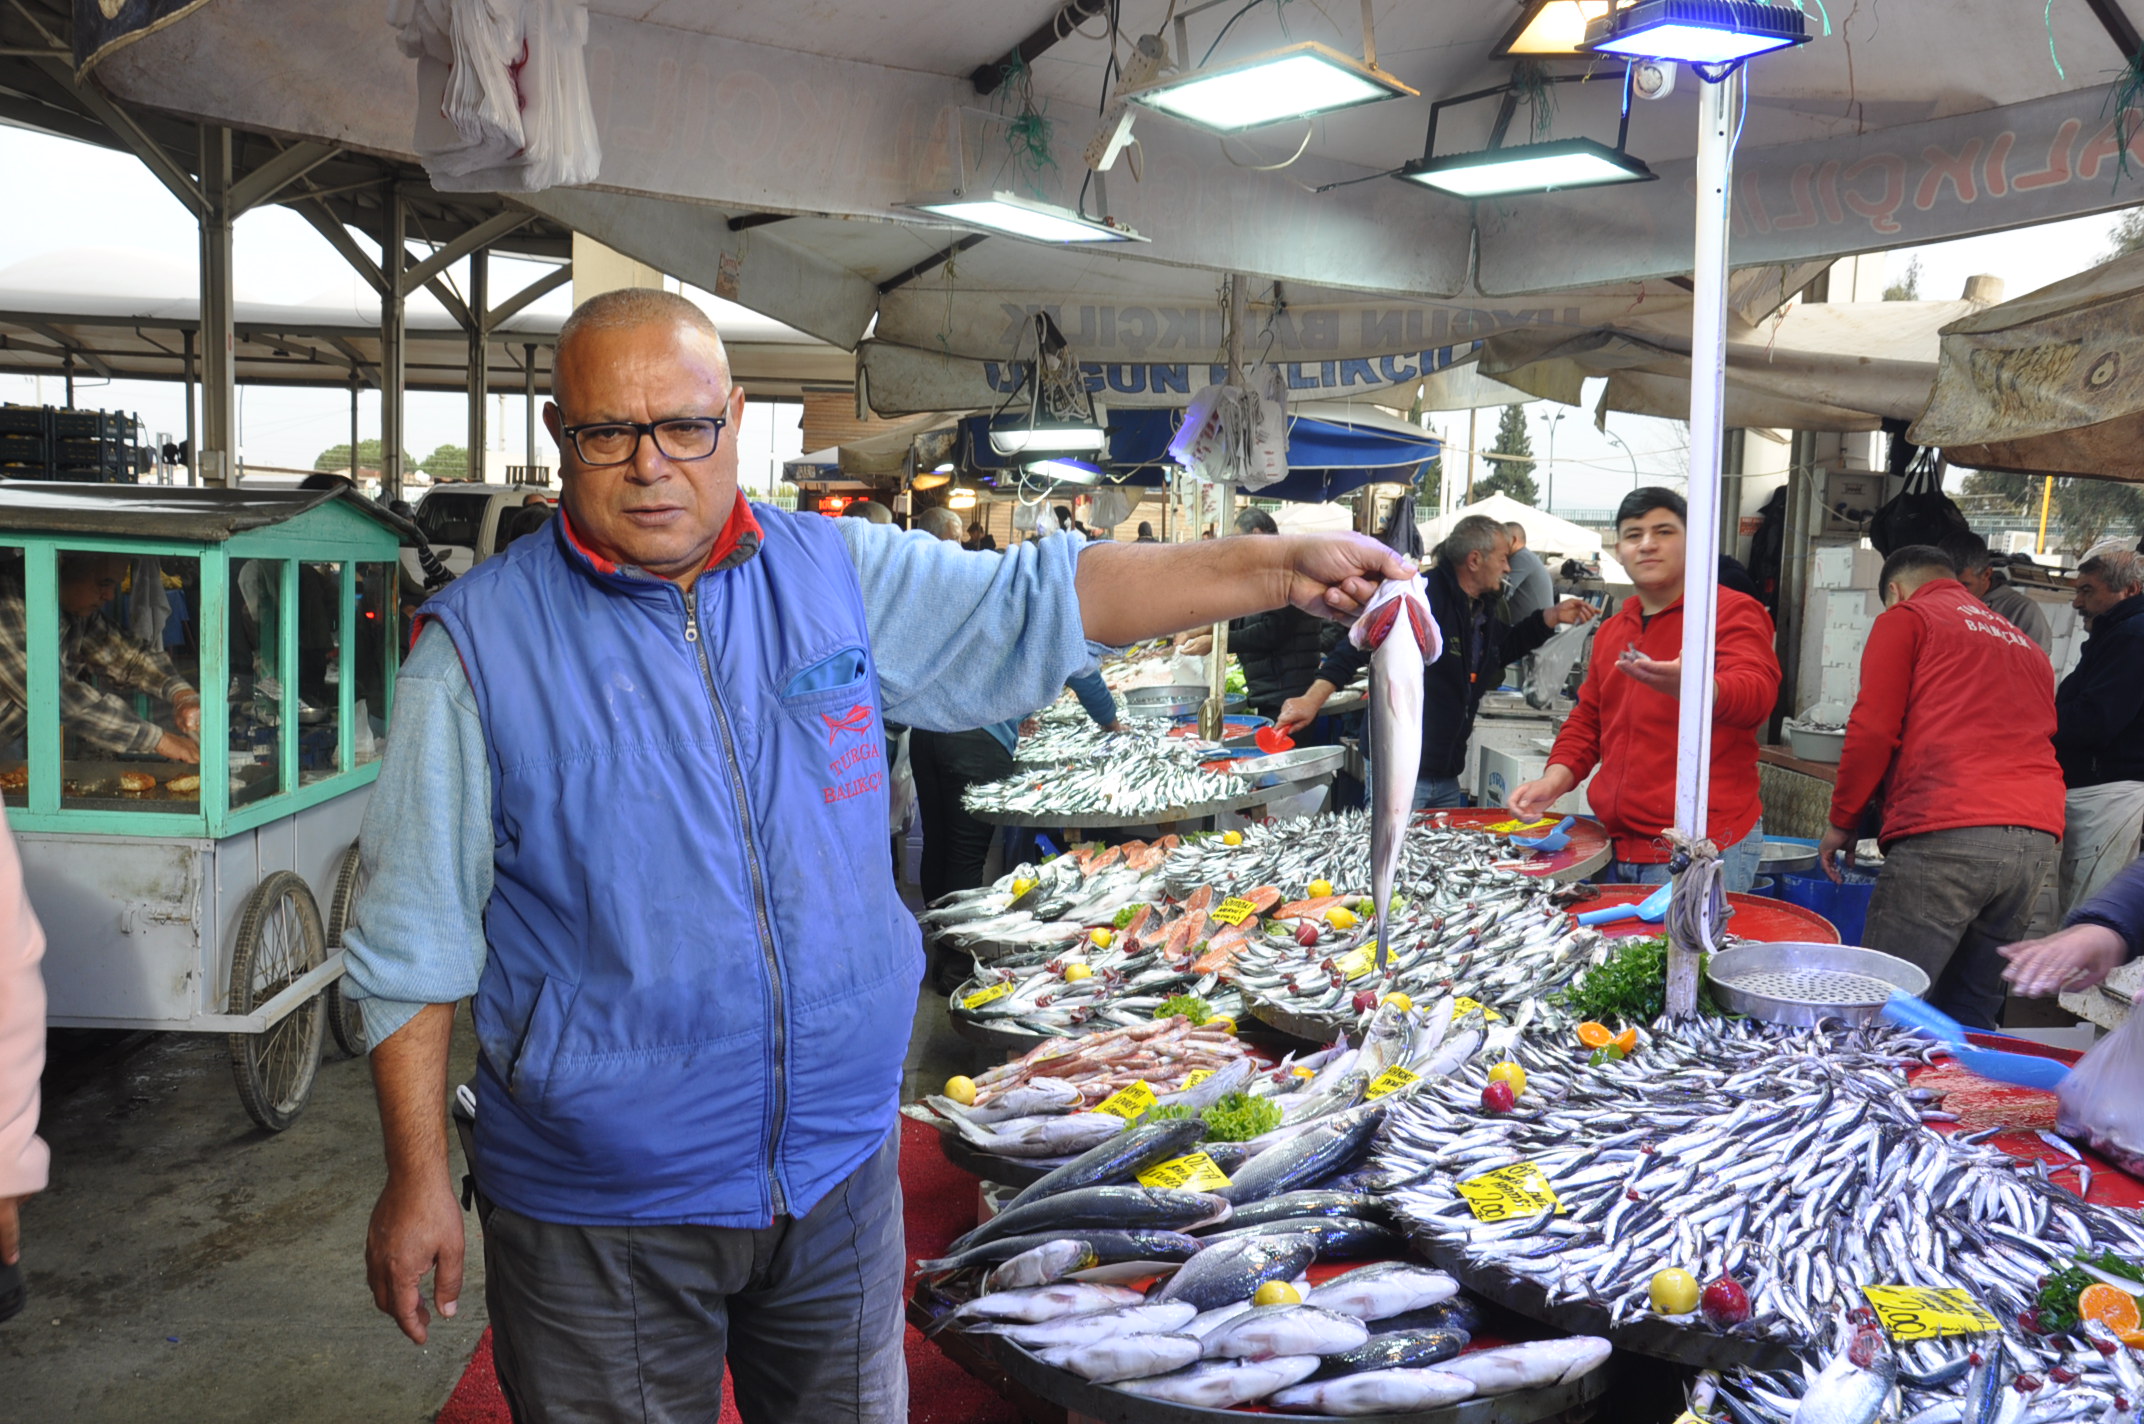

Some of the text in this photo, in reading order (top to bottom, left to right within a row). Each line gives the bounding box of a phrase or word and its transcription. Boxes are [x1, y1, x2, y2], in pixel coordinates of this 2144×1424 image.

[984, 361, 1191, 394] UGUN
[1468, 1192, 1506, 1218] 200
[1875, 1300, 1927, 1334] 200
